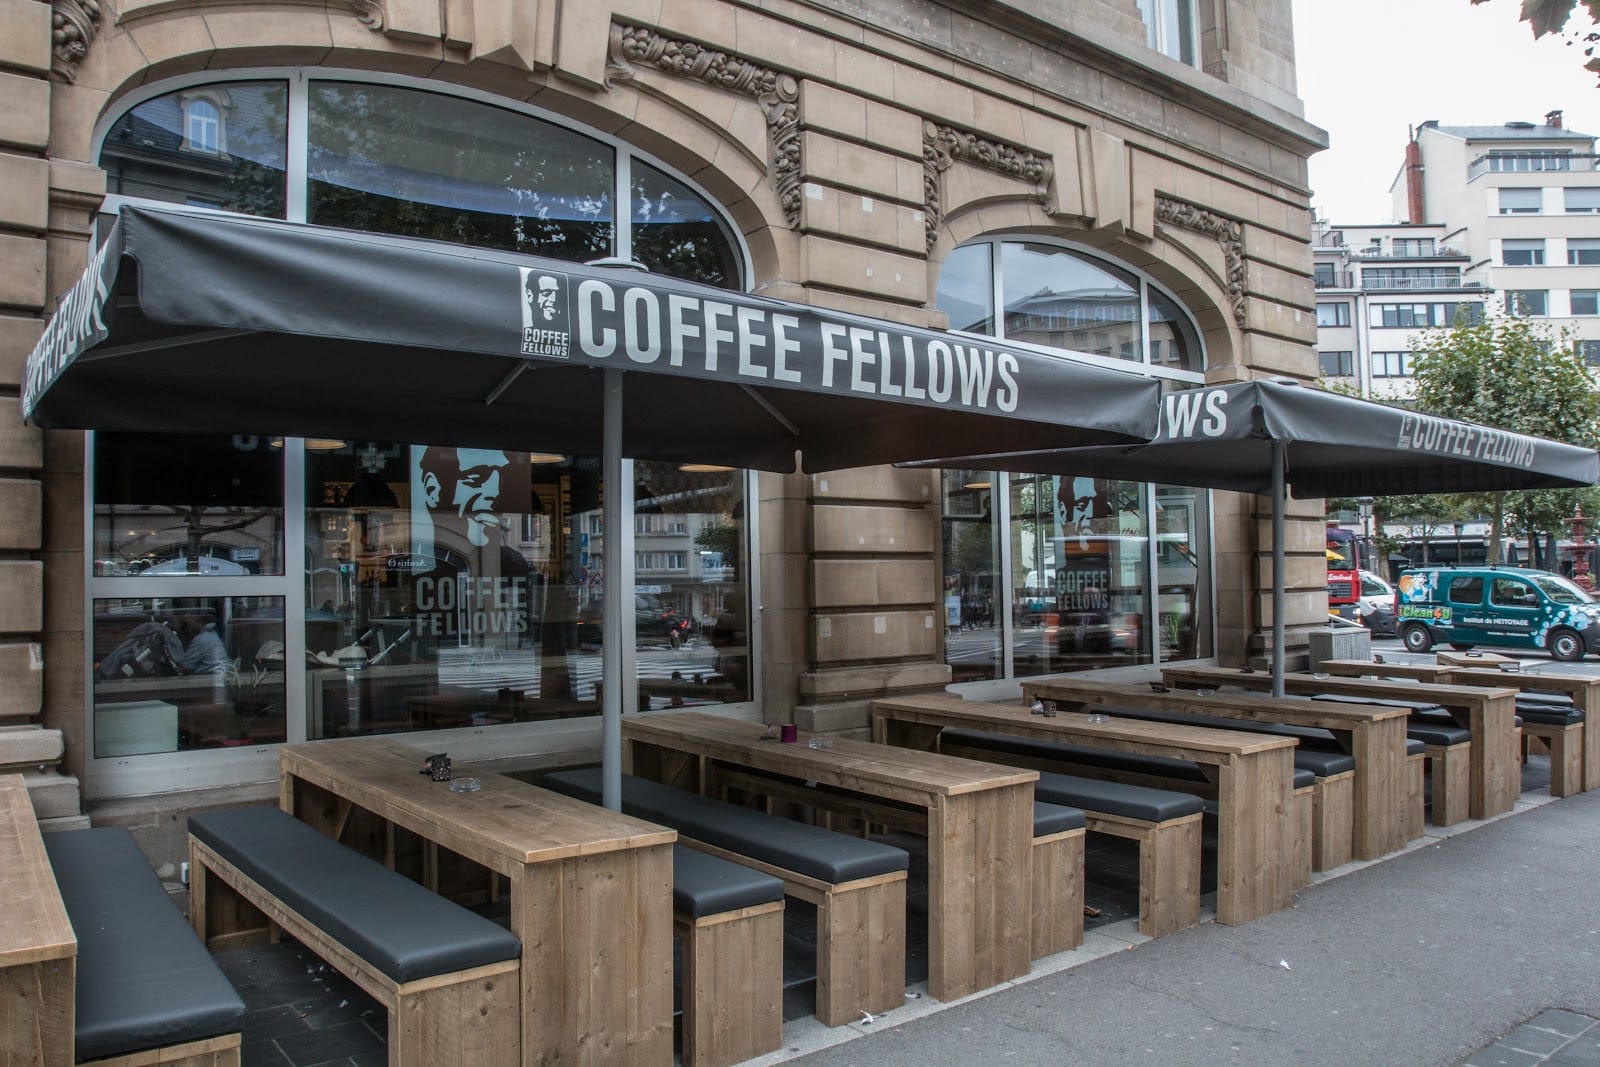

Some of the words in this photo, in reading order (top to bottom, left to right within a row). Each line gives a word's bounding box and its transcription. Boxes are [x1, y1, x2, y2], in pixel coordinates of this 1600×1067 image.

[523, 341, 568, 357] FELLOWS
[524, 328, 568, 347] COFFEE
[578, 279, 801, 383] COFFEE
[820, 321, 1019, 413] FELLOWS
[1158, 389, 1228, 439] WS
[1412, 416, 1474, 456] COFFEE
[1475, 429, 1536, 467] FELLOWS
[416, 576, 527, 611] COFFEE
[1057, 570, 1107, 593] COFFEE
[1057, 593, 1108, 610] FELLOWS
[416, 611, 528, 637] FELLOWS
